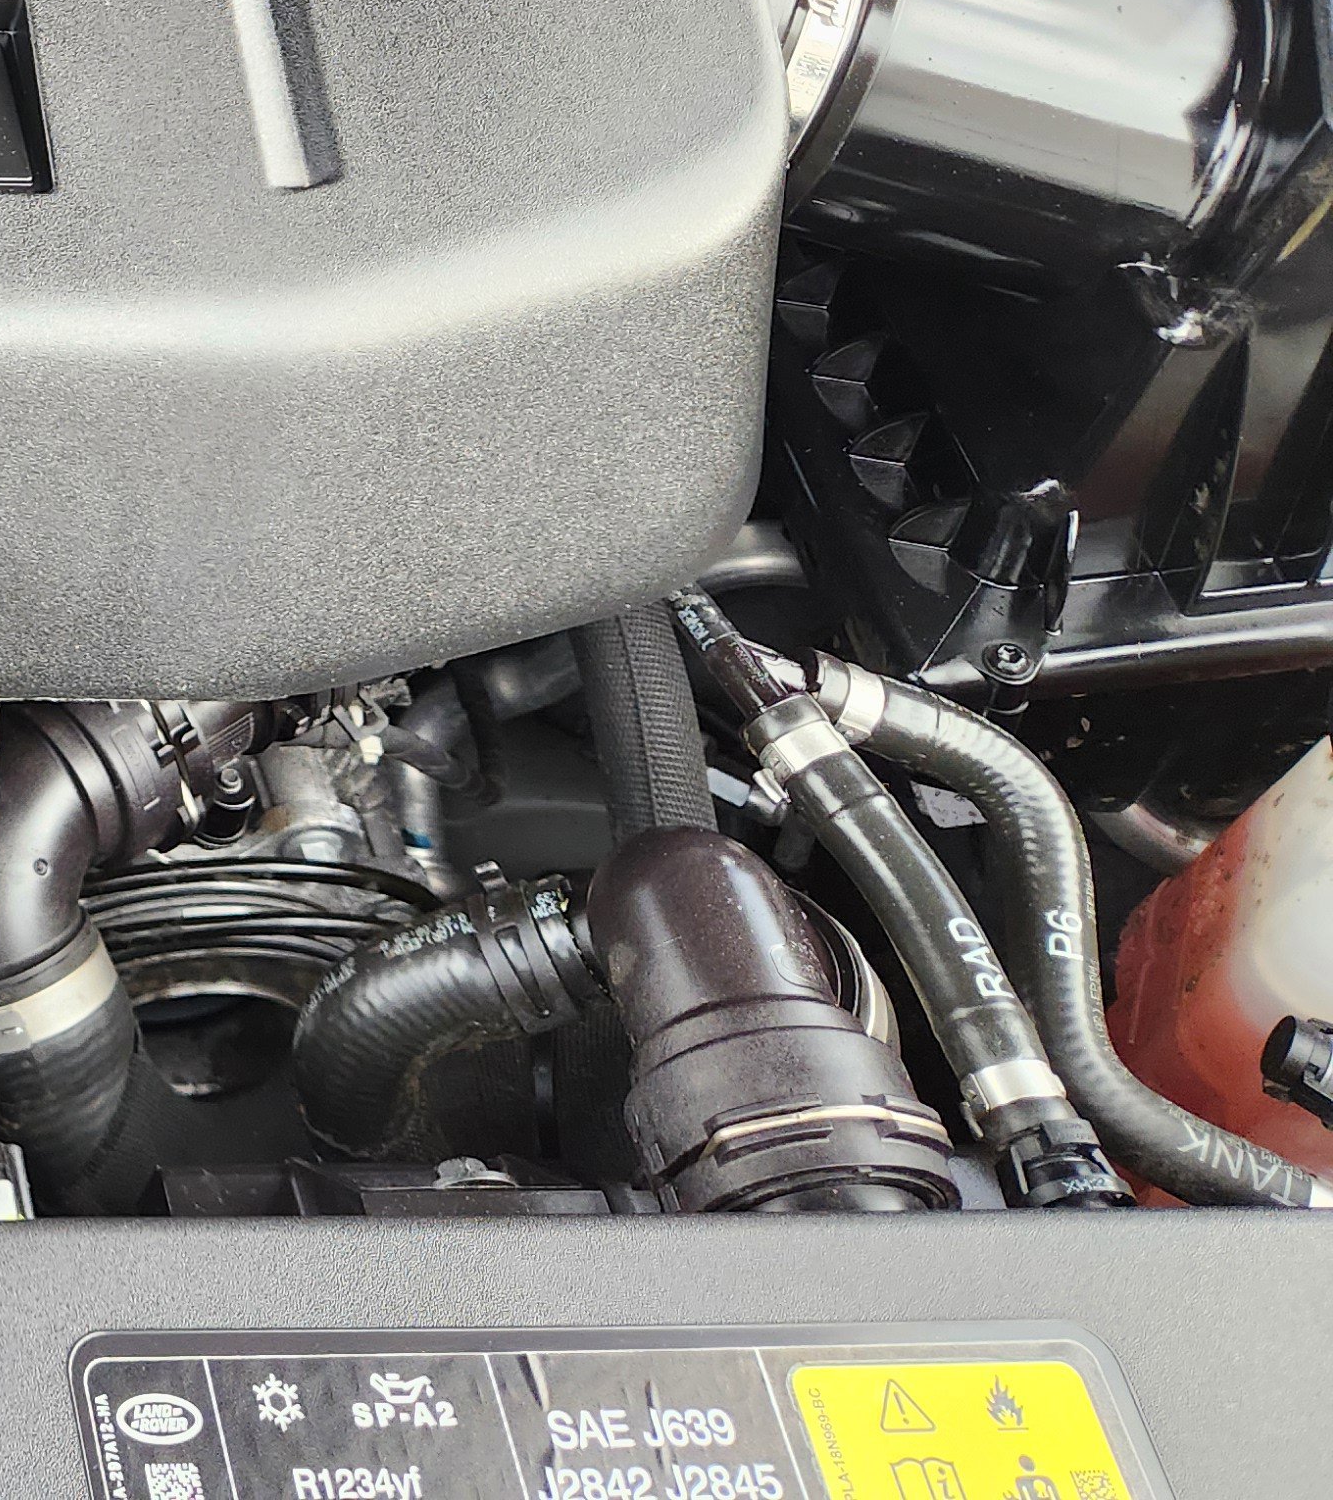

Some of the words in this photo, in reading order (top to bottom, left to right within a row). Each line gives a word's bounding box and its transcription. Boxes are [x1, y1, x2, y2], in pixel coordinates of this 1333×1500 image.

[1046, 909, 1084, 962] P6
[947, 916, 1016, 999] RAD
[1176, 1119, 1300, 1207] TANK
[133, 1403, 173, 1419] LAND
[139, 1416, 189, 1434] ROVER
[351, 1401, 459, 1429] SP-A2
[546, 1408, 637, 1450] SAE
[642, 1407, 736, 1448] J639
[292, 1465, 423, 1500] R1234yf
[537, 1465, 659, 1500] J2842
[664, 1462, 784, 1500] J2845
